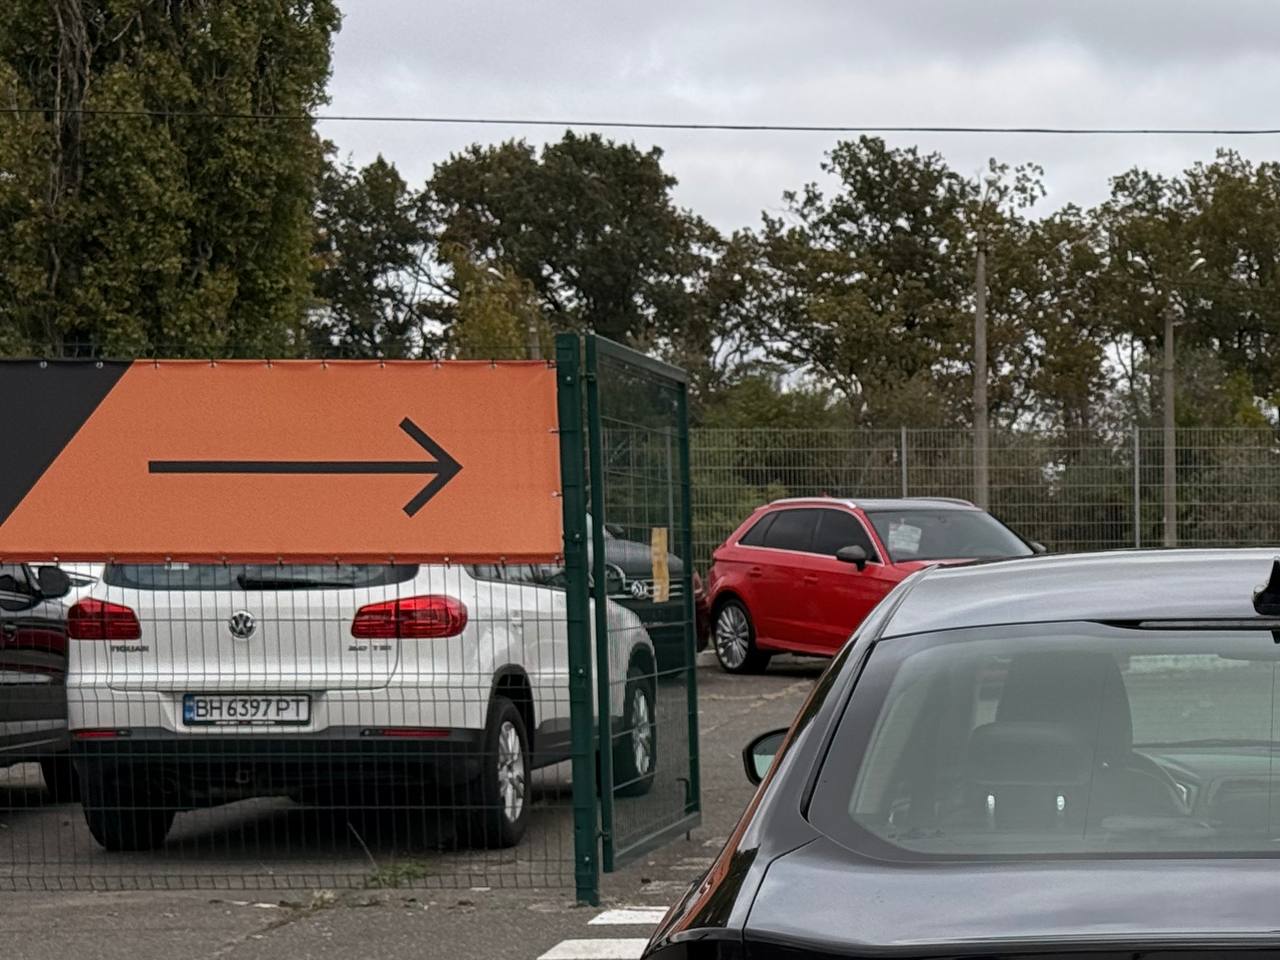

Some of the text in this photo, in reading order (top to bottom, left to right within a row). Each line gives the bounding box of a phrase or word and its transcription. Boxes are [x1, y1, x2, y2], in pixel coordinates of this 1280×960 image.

[196, 699, 305, 718] BH 6397 PT
